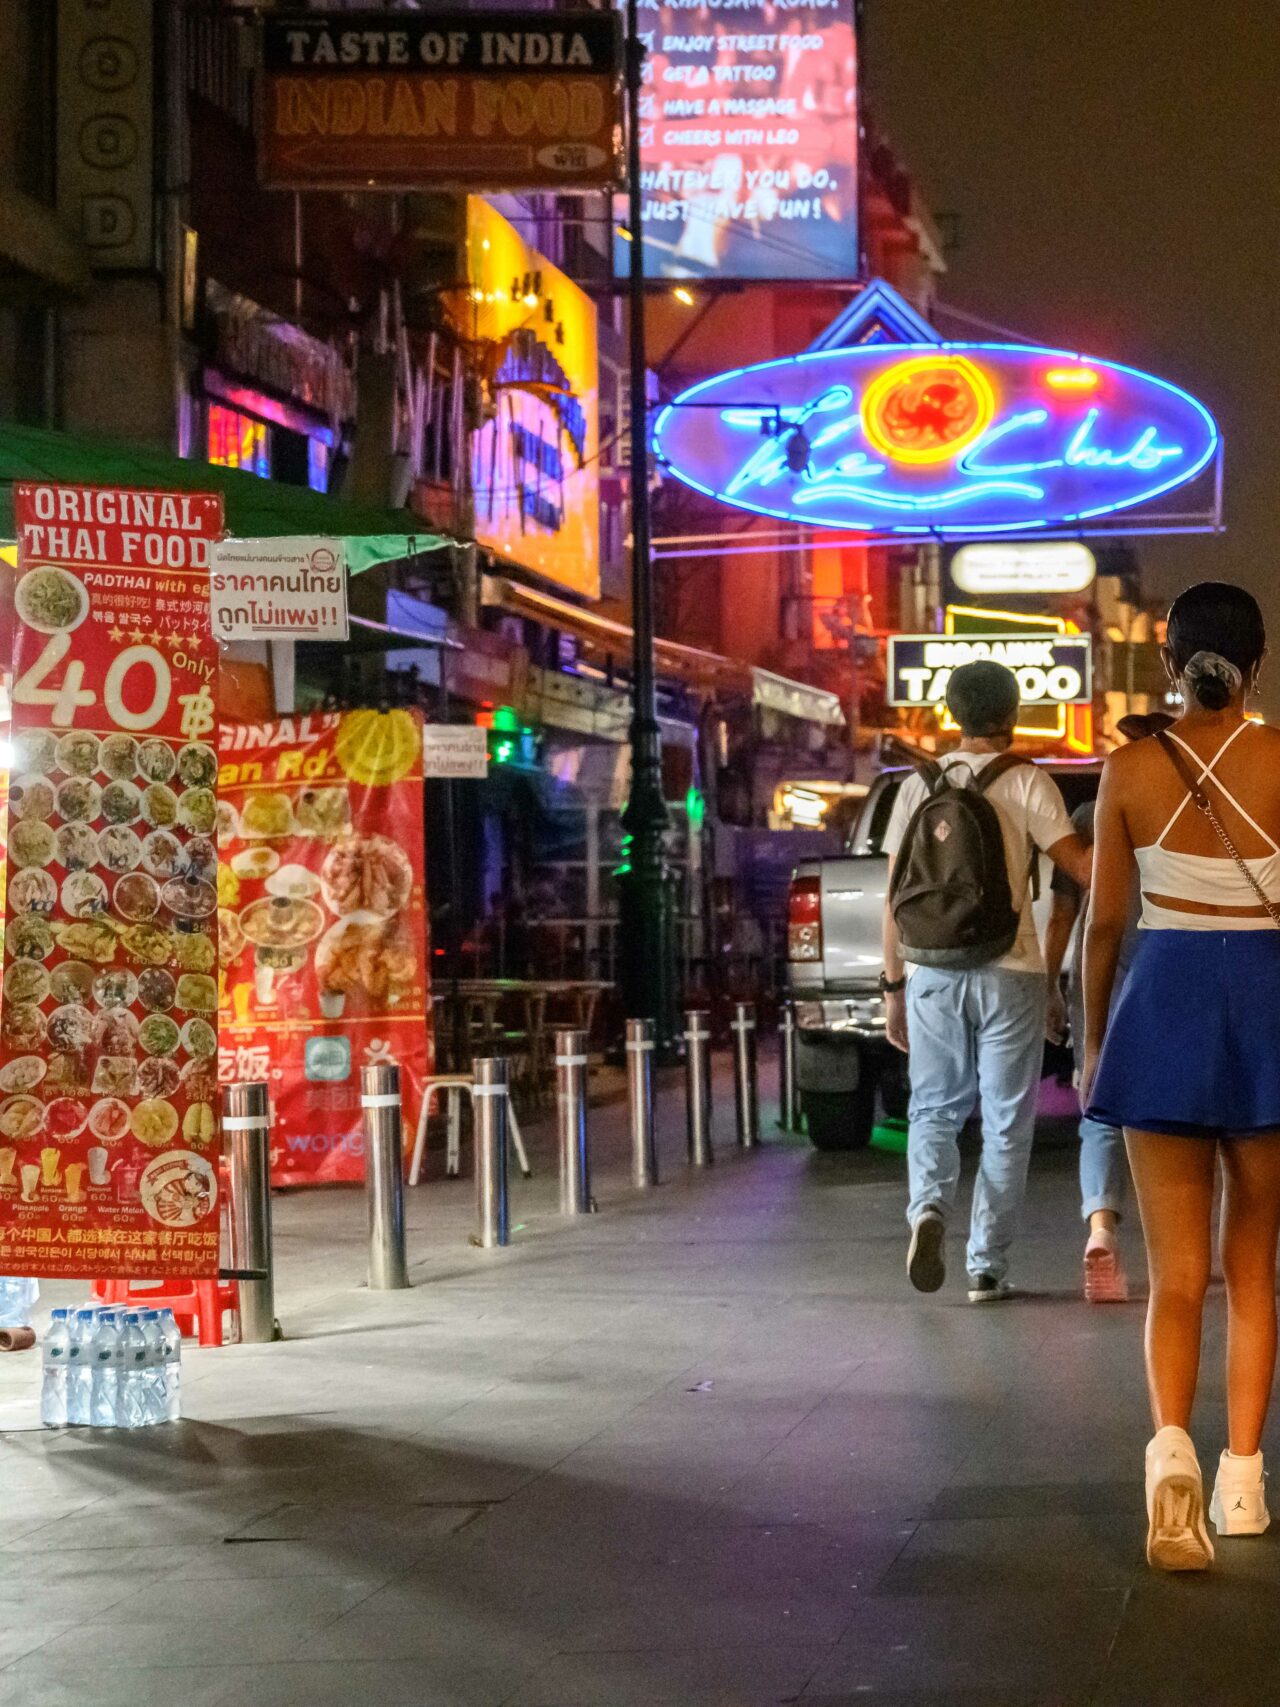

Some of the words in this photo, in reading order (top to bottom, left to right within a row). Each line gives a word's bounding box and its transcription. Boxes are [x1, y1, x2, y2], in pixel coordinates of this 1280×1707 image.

[287, 32, 409, 64] TASTE
[420, 33, 469, 64] OF
[481, 33, 593, 65] INDIA
[662, 35, 714, 51] ENJOY
[717, 35, 777, 52] STREET
[780, 34, 824, 50] FOOD
[663, 66, 691, 82] GET
[713, 65, 777, 81] TATTOO
[275, 78, 459, 136] INDIAN
[472, 79, 604, 137] FOOD
[663, 99, 705, 115] HAVE
[707, 98, 720, 115] A
[723, 98, 796, 116] MASSAGE
[79, 0, 139, 249] OOD
[662, 129, 722, 146] CHEERS
[725, 129, 764, 146] WITH
[766, 128, 800, 146] LEO
[639, 169, 741, 191] HATEVER
[745, 169, 790, 190] YOU
[24, 523, 107, 563] THAI
[121, 530, 210, 569] FOOD
[83, 572, 151, 590] PADTHAI
[155, 579, 187, 593] with
[192, 583, 210, 598] eg
[213, 568, 341, 593] ราคาคนไทย
[217, 600, 337, 632] ถูกไม่แพง!!
[172, 651, 216, 683] Only
[13, 633, 172, 731] 40
[899, 666, 1082, 701] TAOO
[276, 747, 337, 781] Rd.
[12, 1204, 50, 1213] Pineapple
[59, 1204, 88, 1214] Orange
[98, 1206, 121, 1214] Water
